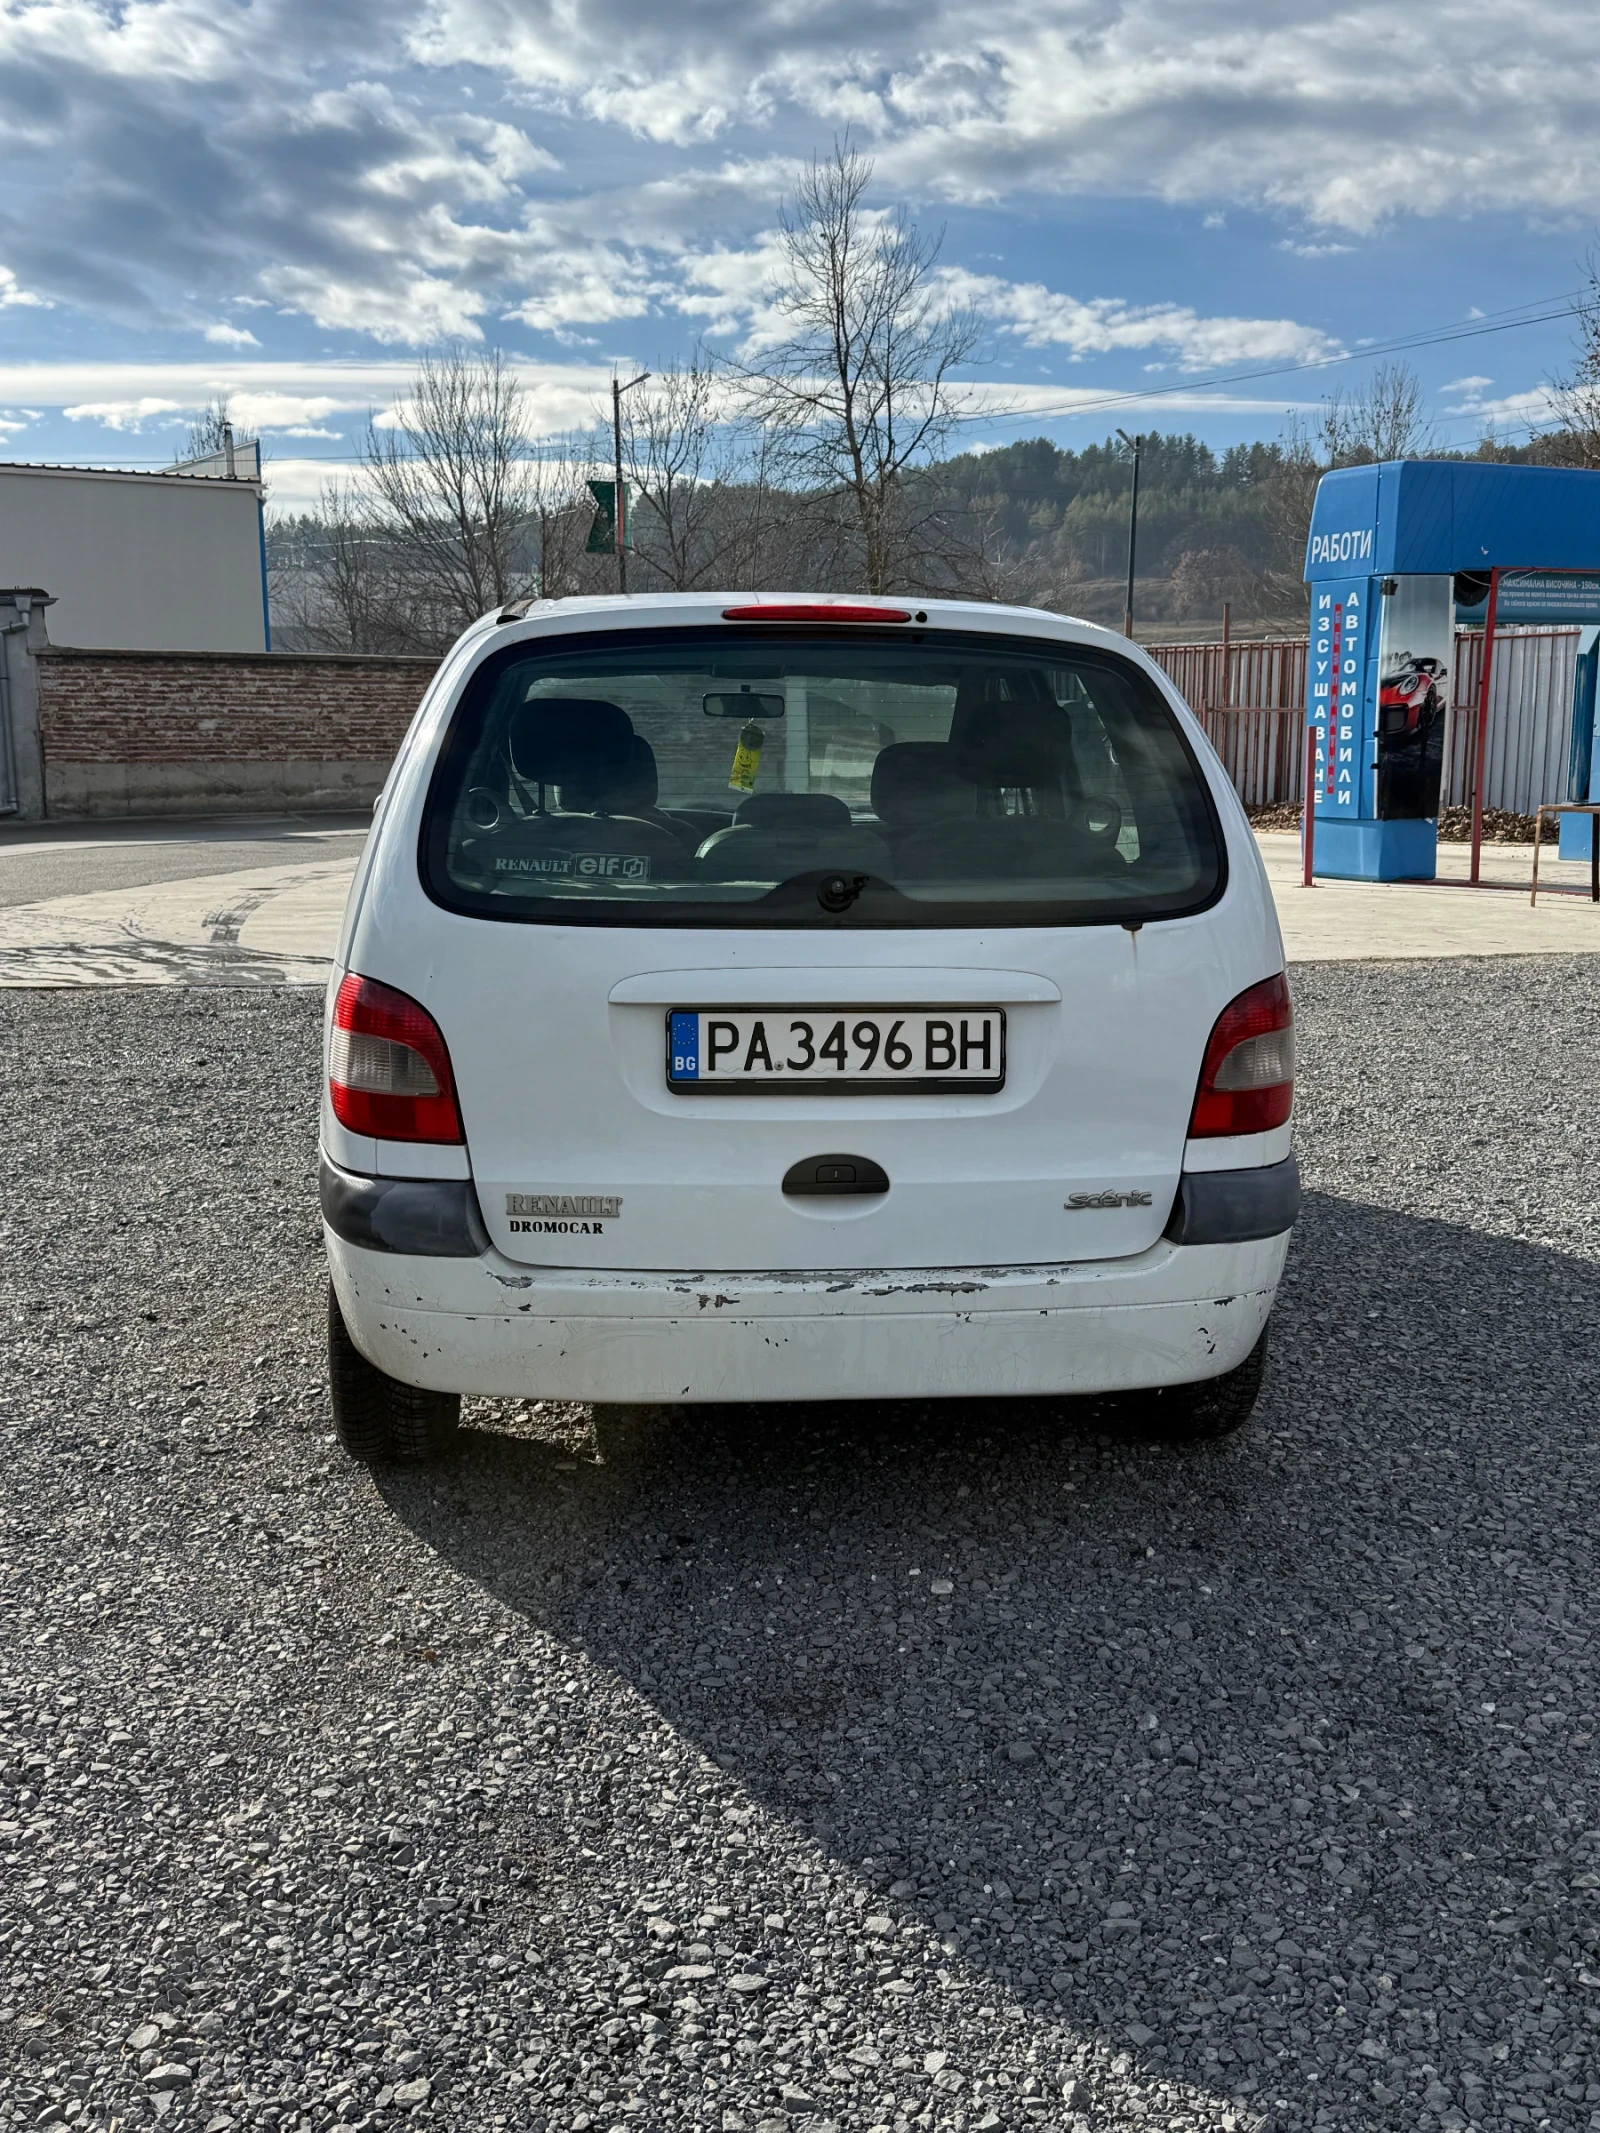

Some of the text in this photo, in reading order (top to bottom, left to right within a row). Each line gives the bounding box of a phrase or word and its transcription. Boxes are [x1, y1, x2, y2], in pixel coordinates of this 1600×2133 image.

[1311, 529, 1372, 564] РАБОТИ
[1546, 579, 1577, 589] ВИСОЧИНА
[1314, 594, 1331, 803] ИЗСУШАВАНЕ
[1338, 592, 1359, 804] АВТОМОБИЛИ
[495, 858, 571, 873] RENAULT
[579, 857, 619, 875] elf
[674, 1056, 696, 1071] BG
[505, 1193, 623, 1218] RENAULT
[509, 1220, 604, 1235] DROMOCAR
